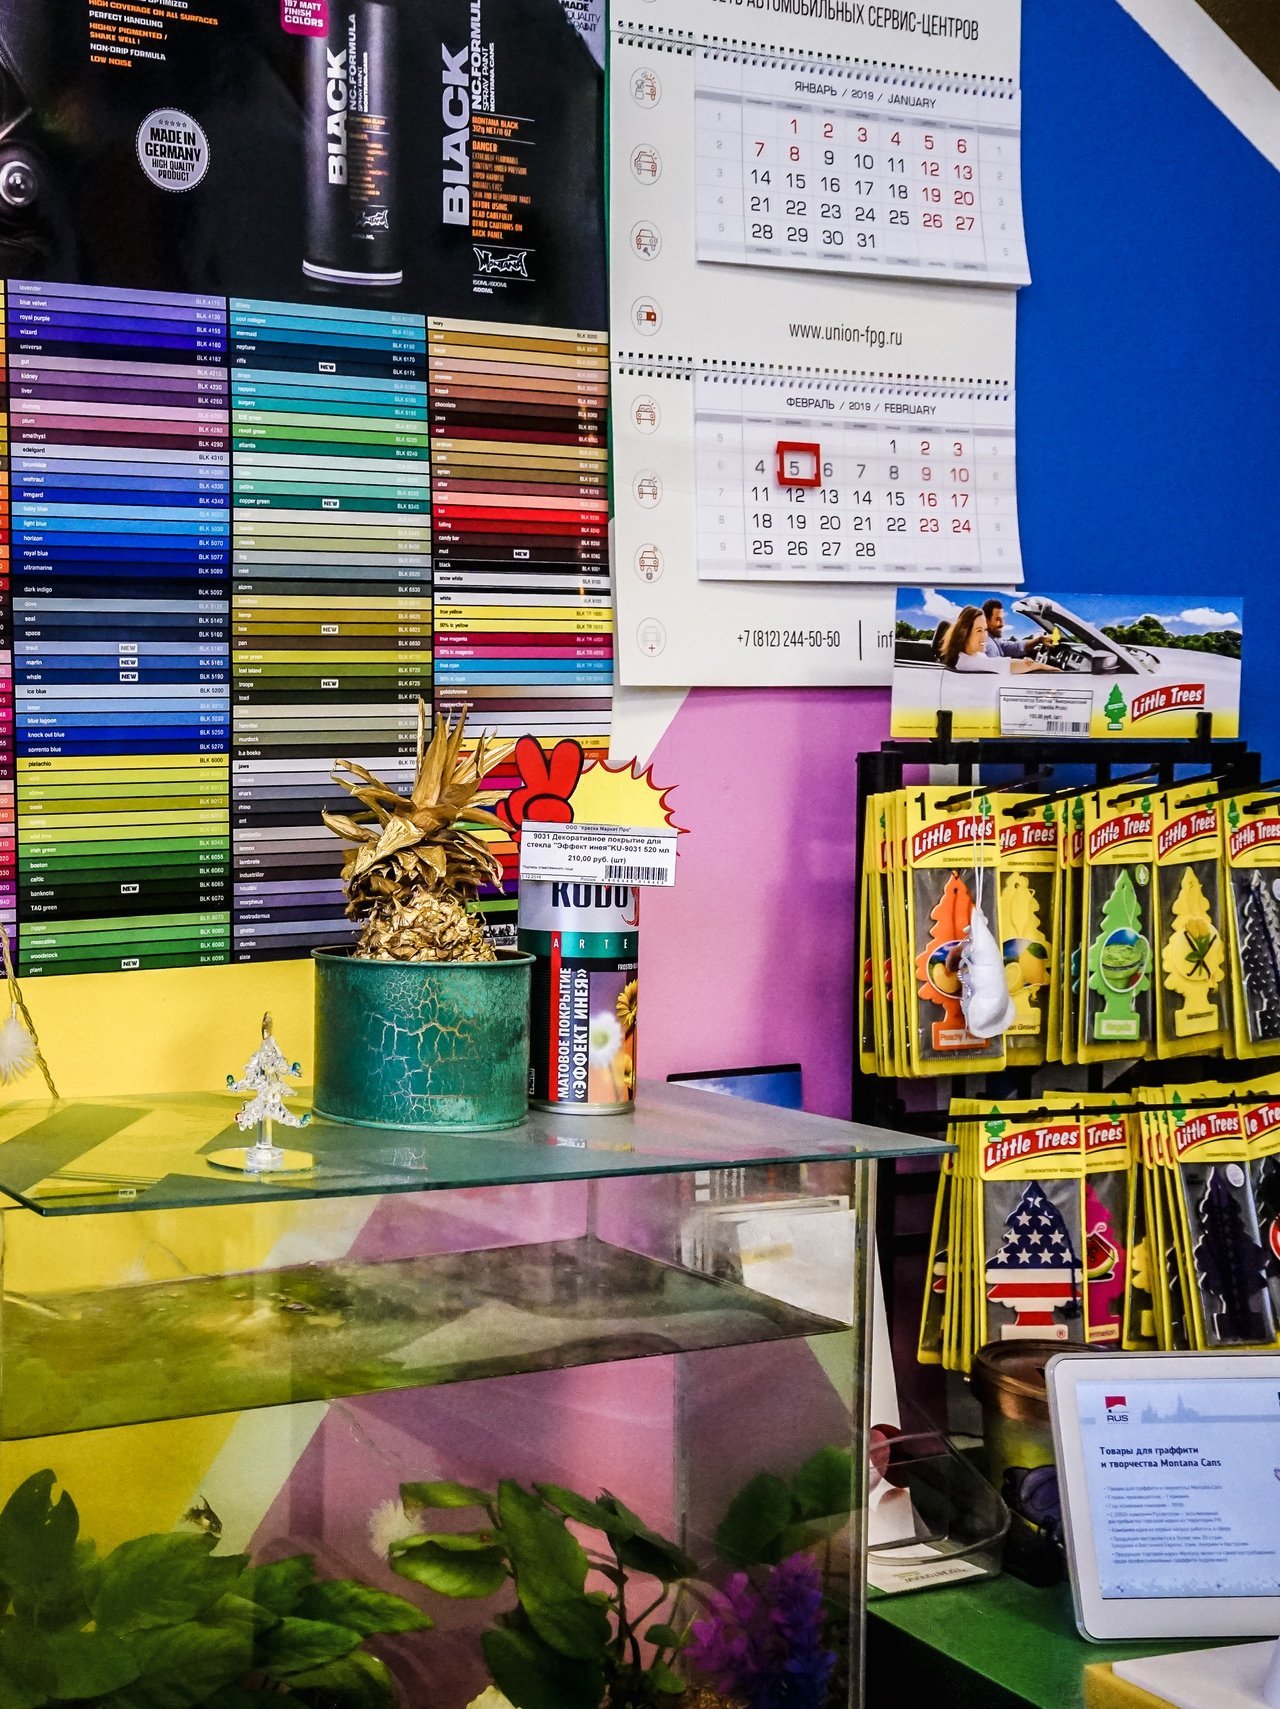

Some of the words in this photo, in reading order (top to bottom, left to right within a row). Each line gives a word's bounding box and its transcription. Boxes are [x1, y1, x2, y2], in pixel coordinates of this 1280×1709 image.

[110, 1, 151, 14] COVERAGE
[153, 9, 165, 17] ON
[166, 11, 178, 19] ALL
[180, 13, 218, 26] SURFACES
[284, 7, 312, 18] FINISH
[299, 0, 322, 11] MATT
[89, 10, 122, 21] PERFECT
[123, 15, 163, 28] HANDLING
[89, 22, 116, 32] HIGHLY
[118, 27, 163, 39] PIGMENTED
[284, 15, 324, 27] COLORS
[868, 5, 979, 41] СЕРВИС-ЦЕНТРОВ
[90, 31, 116, 41] SHAKE
[118, 35, 136, 44] WELL
[90, 43, 129, 55] NON-DRIP
[130, 49, 166, 61] FORMULA
[90, 55, 107, 64] LOW
[108, 58, 132, 68] NOISE
[348, 13, 357, 111] NC.FORMULA
[470, 0, 482, 111] NC.FORMUL
[482, 78, 490, 111] SPRAY
[794, 81, 837, 97] ЯНВАРЬ
[851, 89, 874, 101] 2019
[888, 94, 937, 109] JANUARY
[326, 46, 348, 185] BLACK
[500, 120, 519, 130] BLACK
[150, 127, 182, 144] MADE
[184, 131, 196, 146] IN
[441, 42, 470, 226] BLACK
[791, 119, 797, 134] 1
[824, 123, 833, 138] 2
[858, 127, 867, 142] 3
[891, 132, 901, 146] 4
[925, 135, 934, 150] 5
[957, 139, 966, 153] 6
[145, 142, 201, 162] GERMANY
[472, 140, 498, 153] DANGER
[152, 158, 168, 170] HIGH
[169, 160, 195, 172] QUALITY
[755, 142, 764, 157] 7
[790, 146, 799, 161] 8
[824, 150, 834, 165] 9
[854, 154, 873, 169] 10
[888, 158, 904, 173] 11
[921, 161, 939, 176] 12
[954, 165, 972, 180] 13
[158, 169, 189, 182] PRODUCT
[751, 169, 771, 185] 14
[786, 173, 805, 189] 15
[821, 177, 840, 192] 16
[855, 181, 873, 195] 17
[889, 184, 908, 199] 18
[922, 188, 941, 202] 19
[954, 190, 974, 206] 20
[751, 196, 769, 212] 21
[786, 200, 806, 216] 22
[821, 204, 841, 219] 23
[855, 207, 875, 222] 24
[889, 210, 909, 225] 25
[923, 213, 942, 228] 26
[956, 216, 974, 230] 27
[752, 224, 773, 239] 28
[787, 227, 808, 242] 29
[823, 230, 843, 245] 30
[857, 233, 875, 248] 31
[789, 323, 903, 348] www.union-fpg.ru
[786, 397, 835, 410] ФЕВРАЛЬ
[848, 401, 871, 411] 2019
[884, 403, 937, 416] FEBRUARY
[36, 586, 53, 594] indigo
[737, 630, 750, 647] +7
[753, 630, 781, 647] (812)
[783, 630, 840, 647] 244-50-50
[1132, 689, 1166, 718] Little
[1171, 687, 1202, 704] Trees
[914, 792, 927, 821] 1
[1091, 791, 1101, 819] 1
[1159, 793, 1169, 820] 1
[533, 832, 551, 840] 9031
[551, 833, 607, 843] Декоративное
[607, 837, 646, 845] покрытие
[646, 838, 662, 846] для
[914, 824, 952, 857] Little
[957, 820, 993, 840] Trees
[1021, 825, 1055, 844] Trees
[1091, 822, 1119, 854] Little
[1123, 817, 1151, 836] Trees
[1159, 820, 1187, 854] Little
[1190, 814, 1216, 834] Trees
[1231, 828, 1255, 856] Little
[1256, 821, 1280, 838] Trees
[553, 842, 588, 851] "Эффект
[567, 854, 592, 863] 210,00
[592, 856, 609, 864] руб.
[610, 856, 627, 865] (шт)
[552, 880, 629, 909] KUDO
[42, 904, 58, 912] green
[239, 912, 270, 920] nostradamus
[558, 967, 572, 1037] ПОКРЫТИЕ
[573, 968, 589, 1020] ИНЕЯ»
[940, 1032, 964, 1042] Peachy
[557, 1039, 570, 1099] МАТОВОЕ
[572, 1024, 588, 1099] «ЭФФЕКТ
[1087, 1126, 1123, 1146] Trees
[1176, 1119, 1207, 1151] Little
[1207, 1114, 1239, 1134] Trees
[986, 1134, 1031, 1167] Little
[1035, 1129, 1078, 1150] Trees
[1107, 1414, 1129, 1422] RUS
[1099, 1446, 1134, 1456] Товары
[1136, 1448, 1153, 1456] для
[1155, 1446, 1199, 1456] граффити
[1109, 1461, 1158, 1470] творчества
[1160, 1458, 1199, 1467] Montana
[1200, 1458, 1222, 1467] Cans
